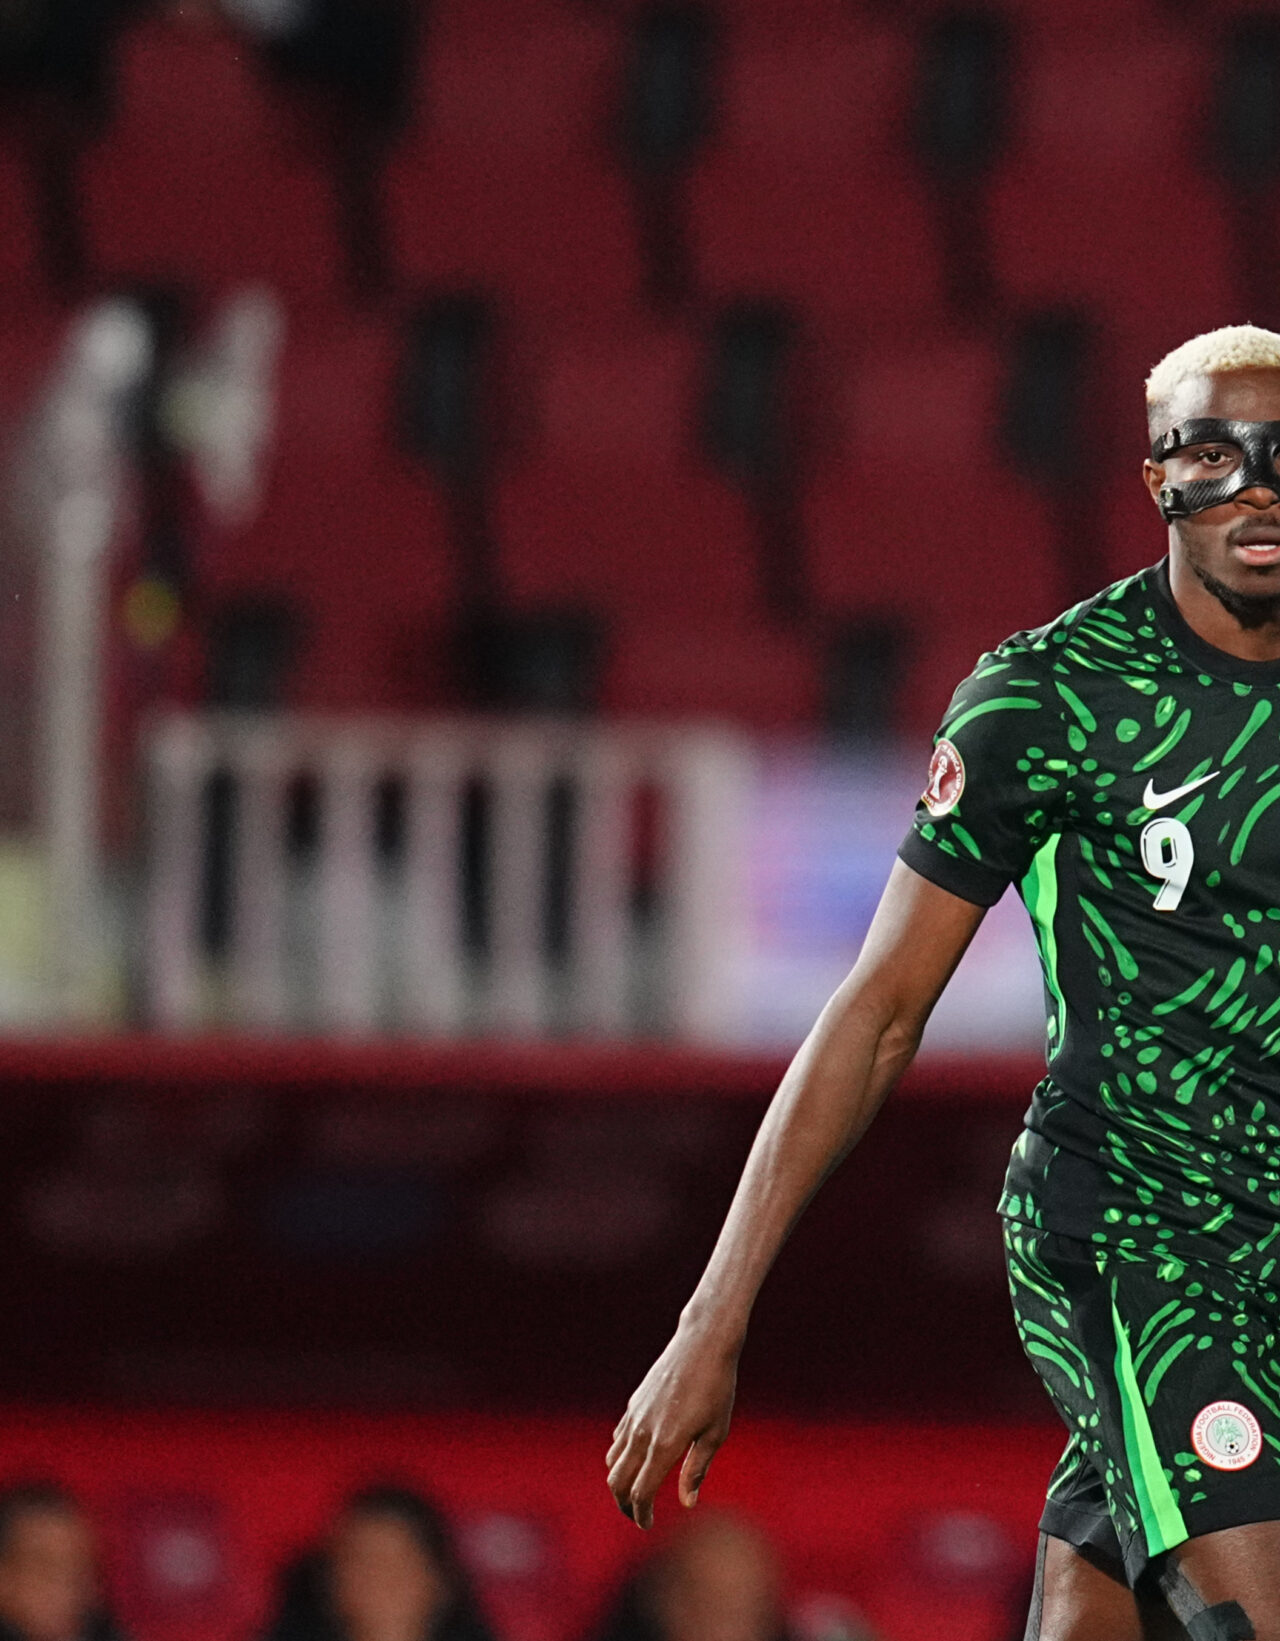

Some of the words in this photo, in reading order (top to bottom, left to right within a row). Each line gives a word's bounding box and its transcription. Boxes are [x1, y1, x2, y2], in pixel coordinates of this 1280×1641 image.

[1140, 817, 1194, 911] 9
[1196, 1405, 1232, 1430] FOOTBALL
[1233, 1406, 1259, 1451] FEDERATION
[1195, 1431, 1216, 1461] NIGERIA
[1228, 1456, 1246, 1465] 1945
